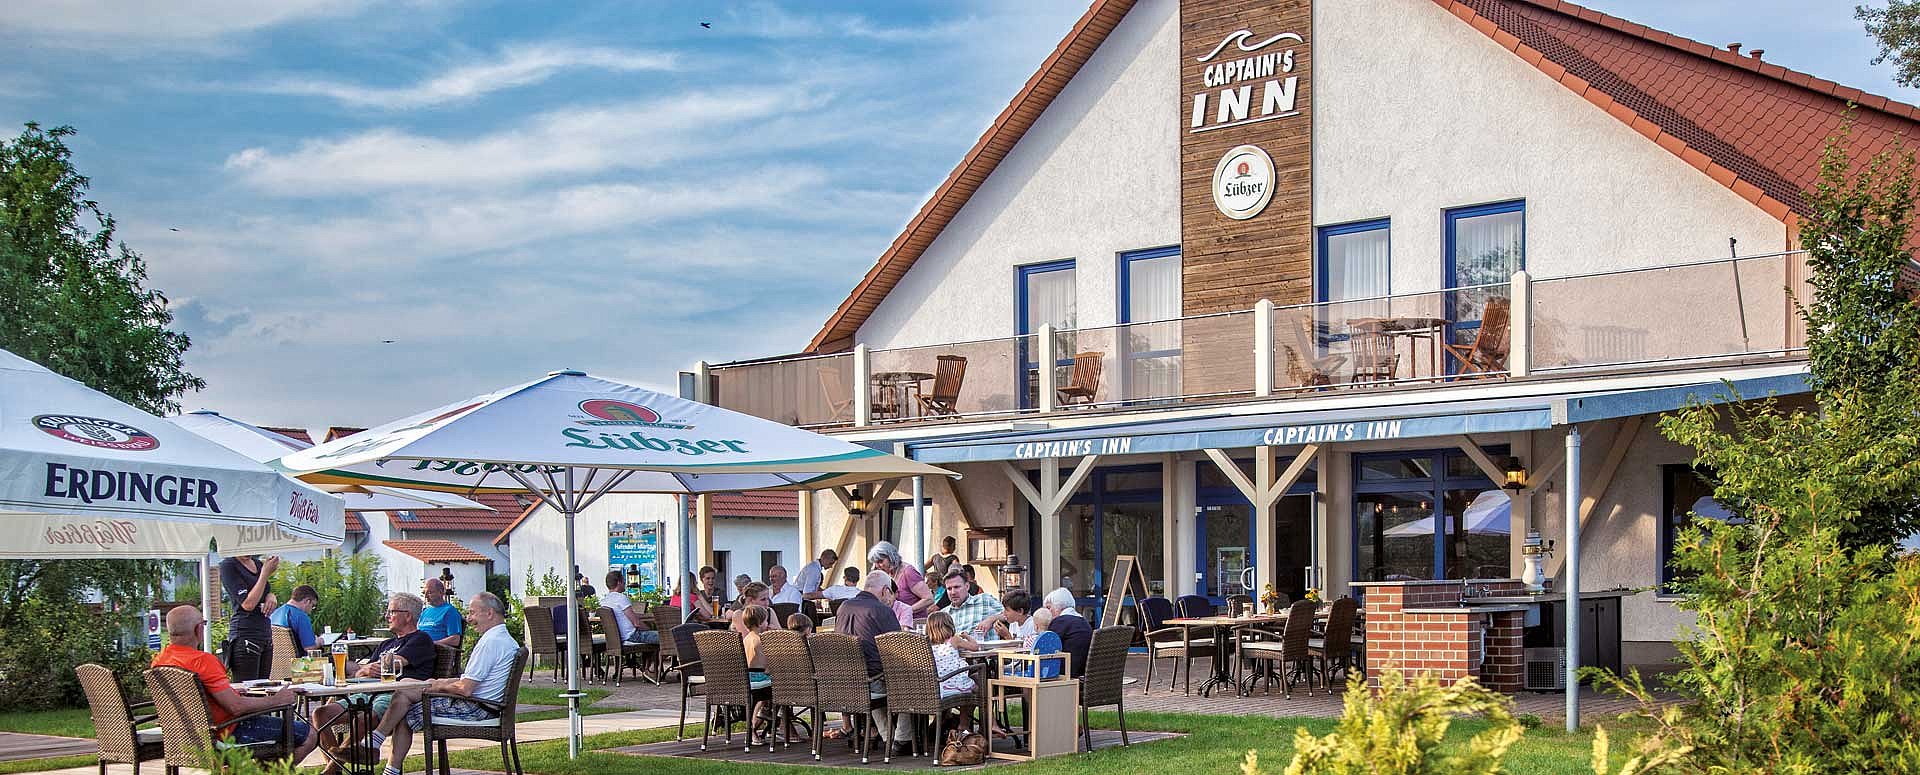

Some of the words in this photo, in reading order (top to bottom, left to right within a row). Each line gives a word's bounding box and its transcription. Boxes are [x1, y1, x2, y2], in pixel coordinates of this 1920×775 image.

[1204, 50, 1294, 87] CAPTAIN'S
[1191, 76, 1298, 128] INN
[1224, 181, 1263, 197] Lübzer
[39, 415, 139, 434] ERDINGER
[1264, 424, 1354, 445] CAPTAIN'S
[1367, 420, 1401, 439] INN
[562, 427, 749, 456] Lübzer
[1015, 440, 1092, 459] CAPTAIN'S
[1102, 437, 1131, 455] INN
[44, 462, 221, 513] ERDINGER
